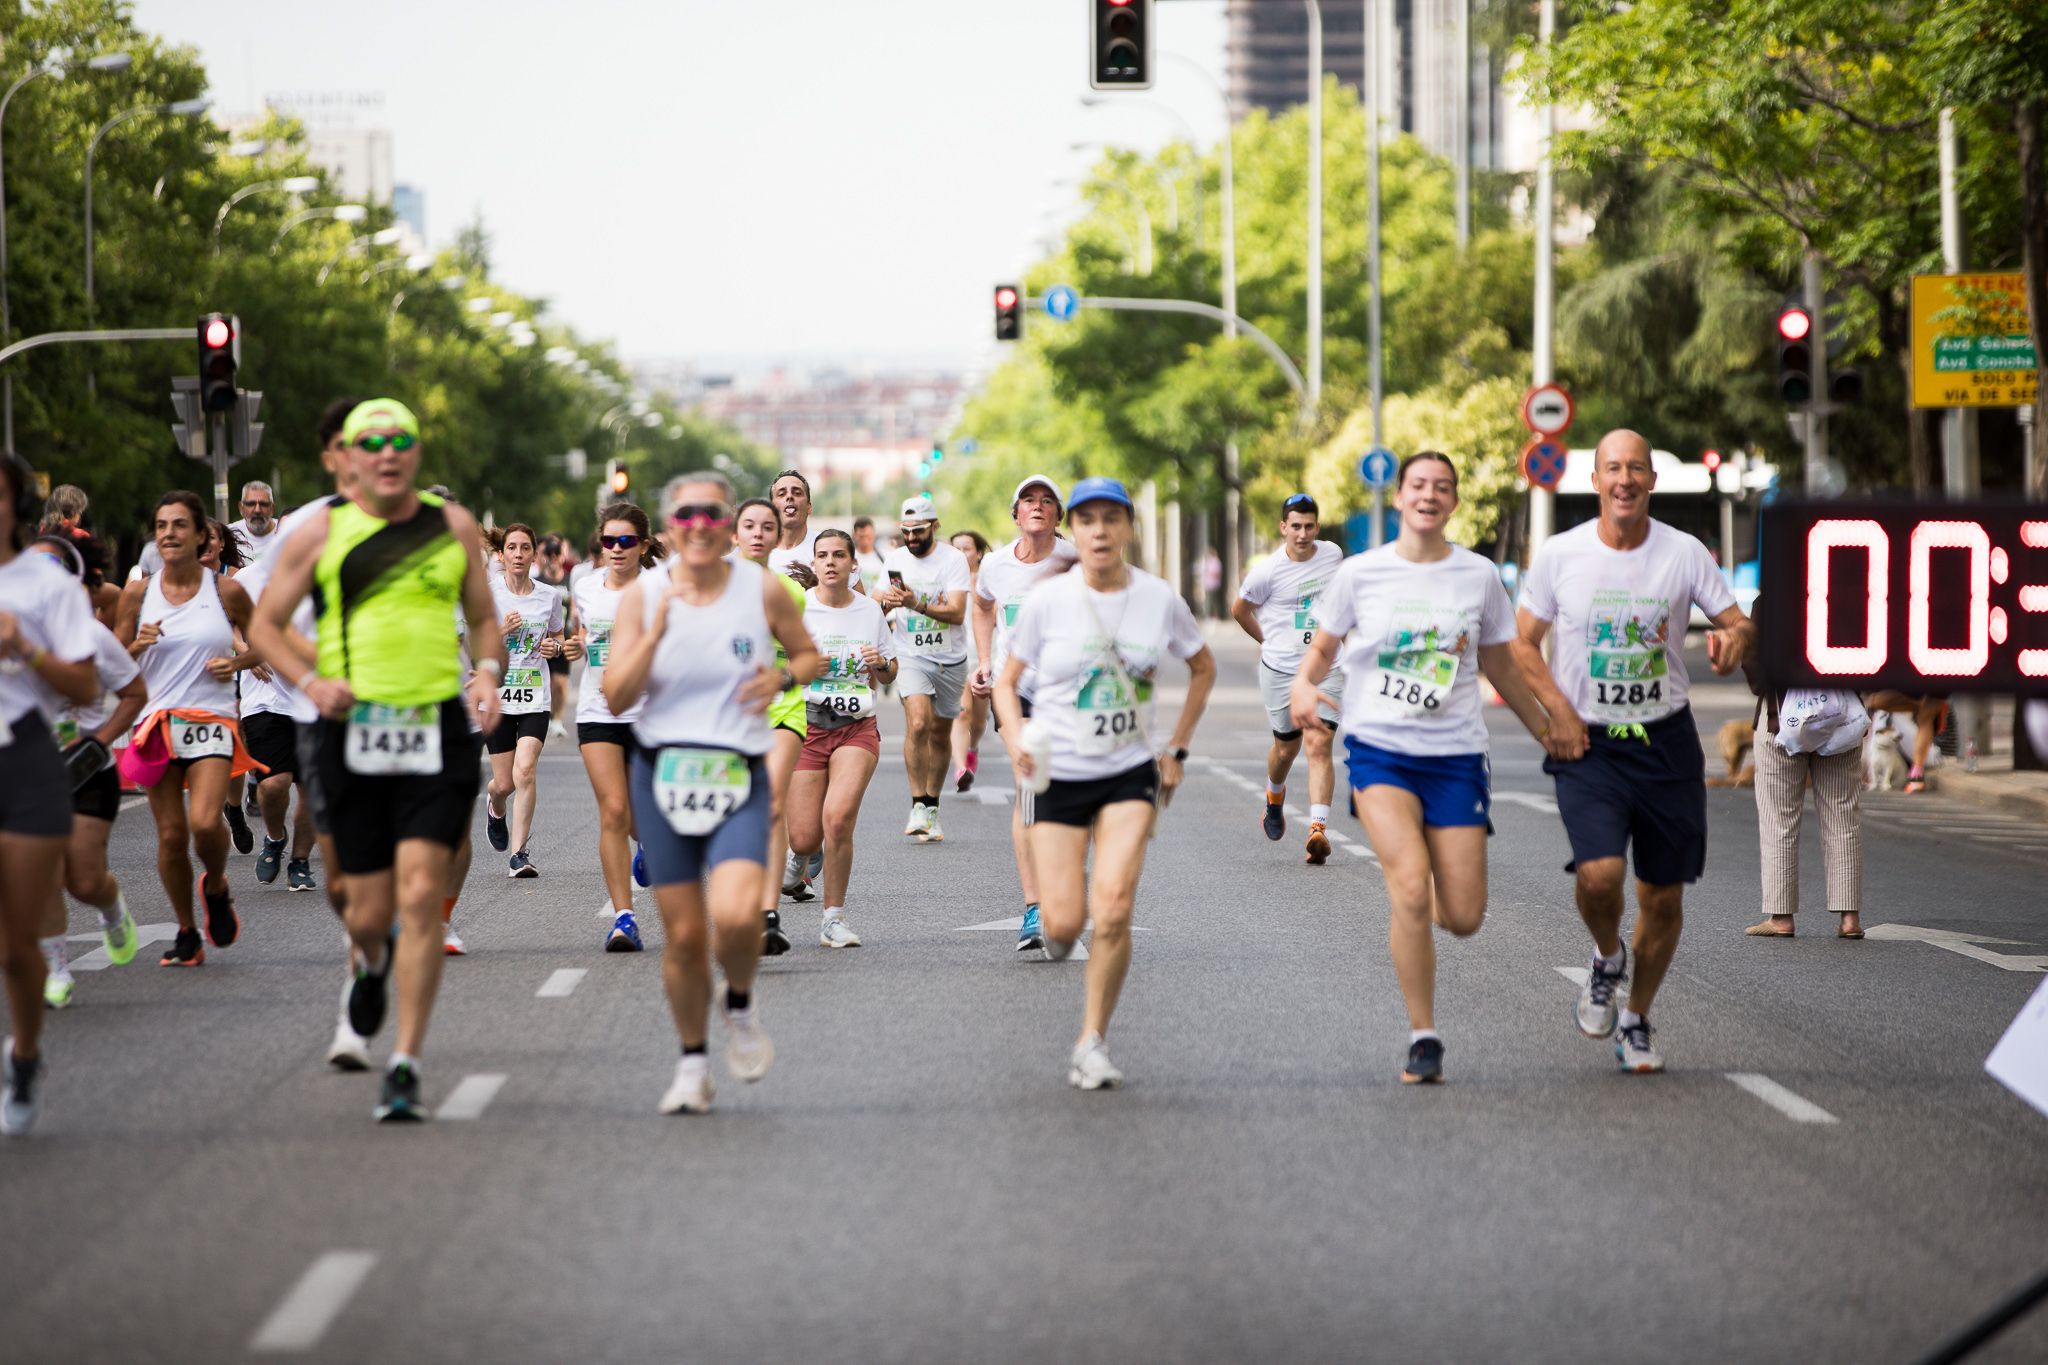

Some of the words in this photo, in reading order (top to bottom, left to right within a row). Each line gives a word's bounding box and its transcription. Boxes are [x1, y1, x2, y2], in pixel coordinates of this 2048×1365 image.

[915, 632, 943, 647] 844
[501, 688, 533, 703] 445
[1380, 674, 1440, 710] 1286
[1597, 681, 1662, 706] 1284
[1797, 694, 1828, 709] KINTO
[820, 696, 860, 713] 488
[1094, 709, 1137, 736] 201
[183, 725, 224, 745] 604
[359, 728, 428, 753] 1438
[668, 789, 736, 817] 1442
